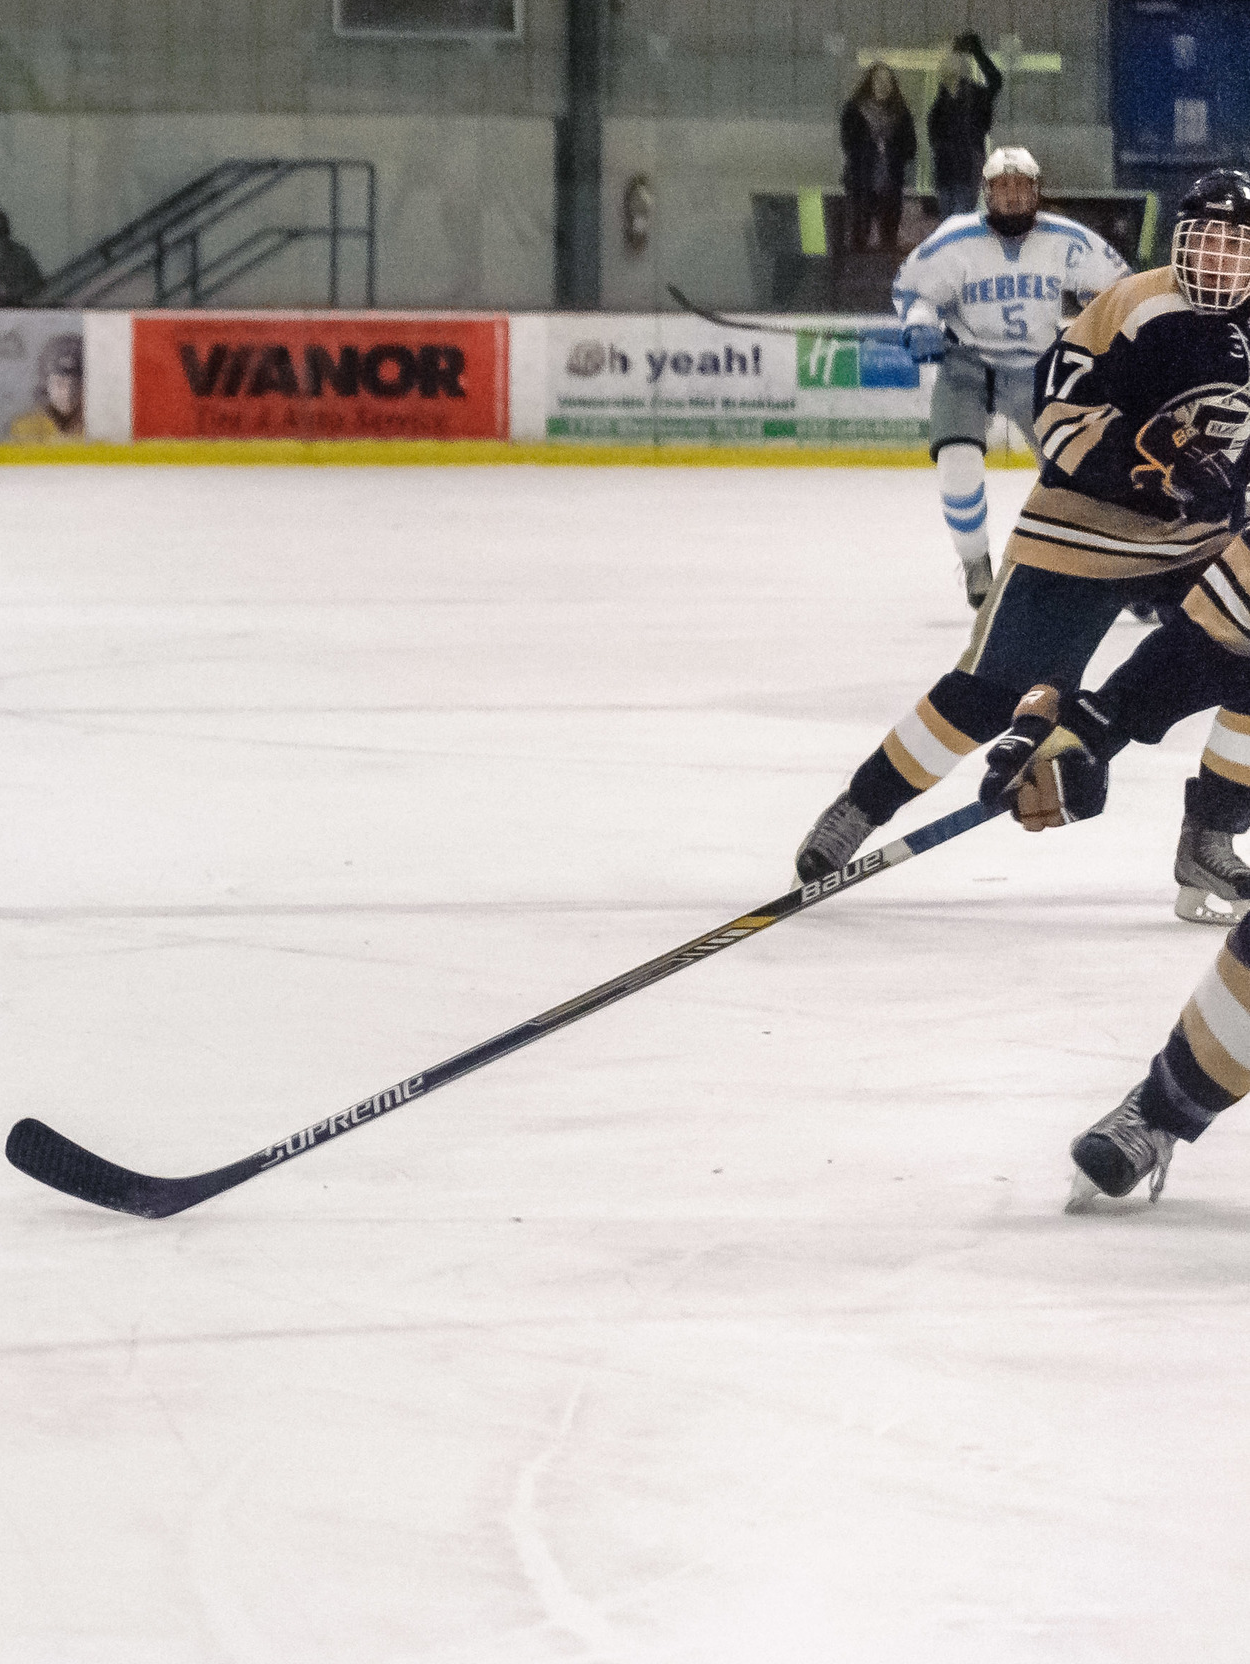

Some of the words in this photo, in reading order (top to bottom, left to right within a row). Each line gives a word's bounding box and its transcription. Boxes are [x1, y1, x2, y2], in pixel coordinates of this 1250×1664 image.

[961, 273, 1062, 304] REBELS
[1001, 302, 1028, 340] 5
[179, 342, 466, 399] VIANOR
[646, 343, 762, 383] yeah!
[1044, 349, 1094, 400] 17
[800, 849, 887, 902] BAUE
[253, 1073, 425, 1171] SUPREME
